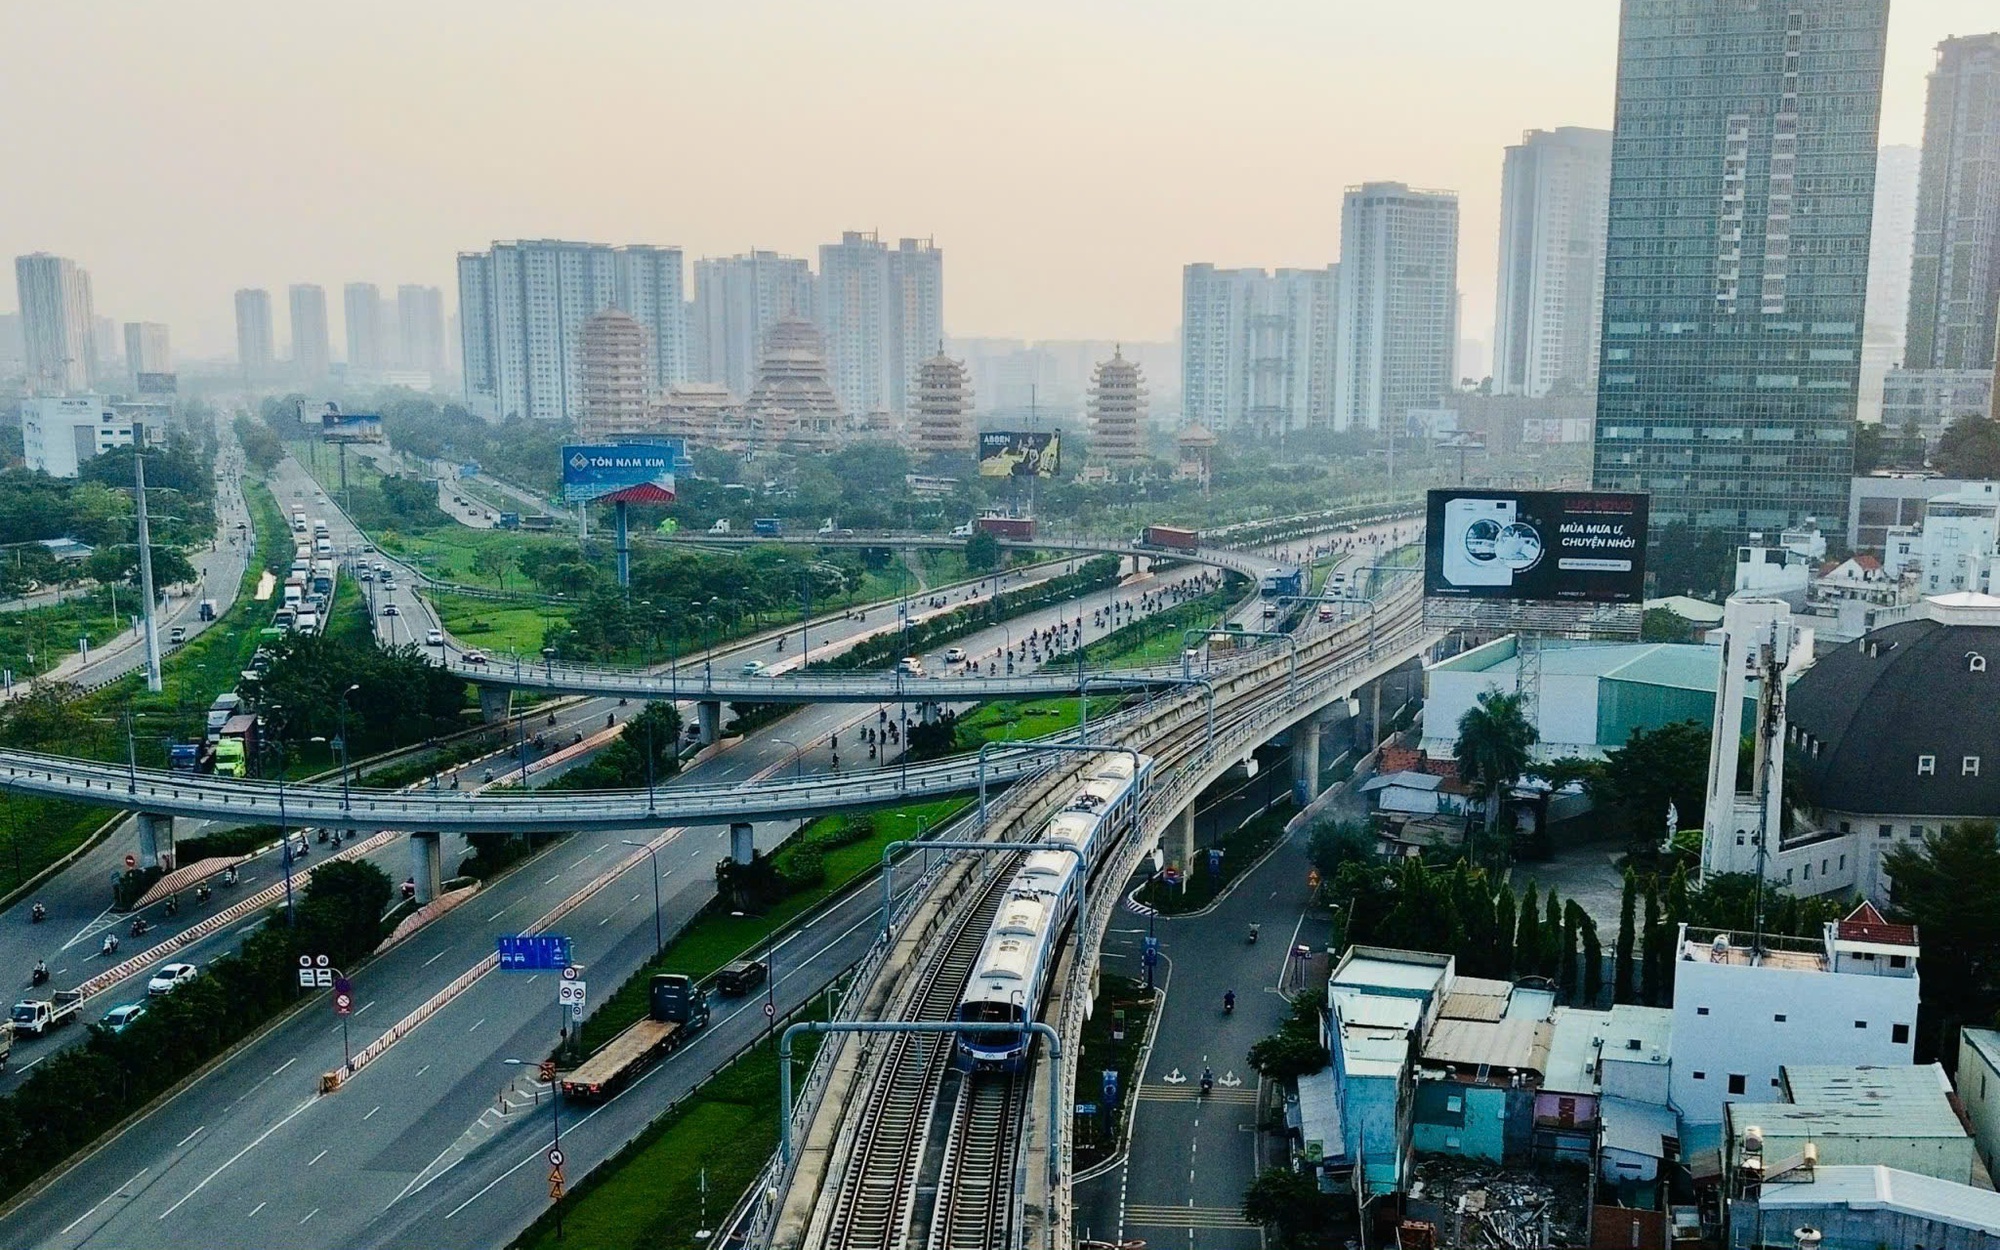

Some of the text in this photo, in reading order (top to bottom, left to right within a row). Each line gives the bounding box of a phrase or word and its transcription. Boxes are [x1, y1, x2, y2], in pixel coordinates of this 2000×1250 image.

[590, 456, 665, 467] TÔN NAM KIM
[1586, 524, 1611, 534] MƯA
[1561, 535, 1606, 549] CHUYỆN
